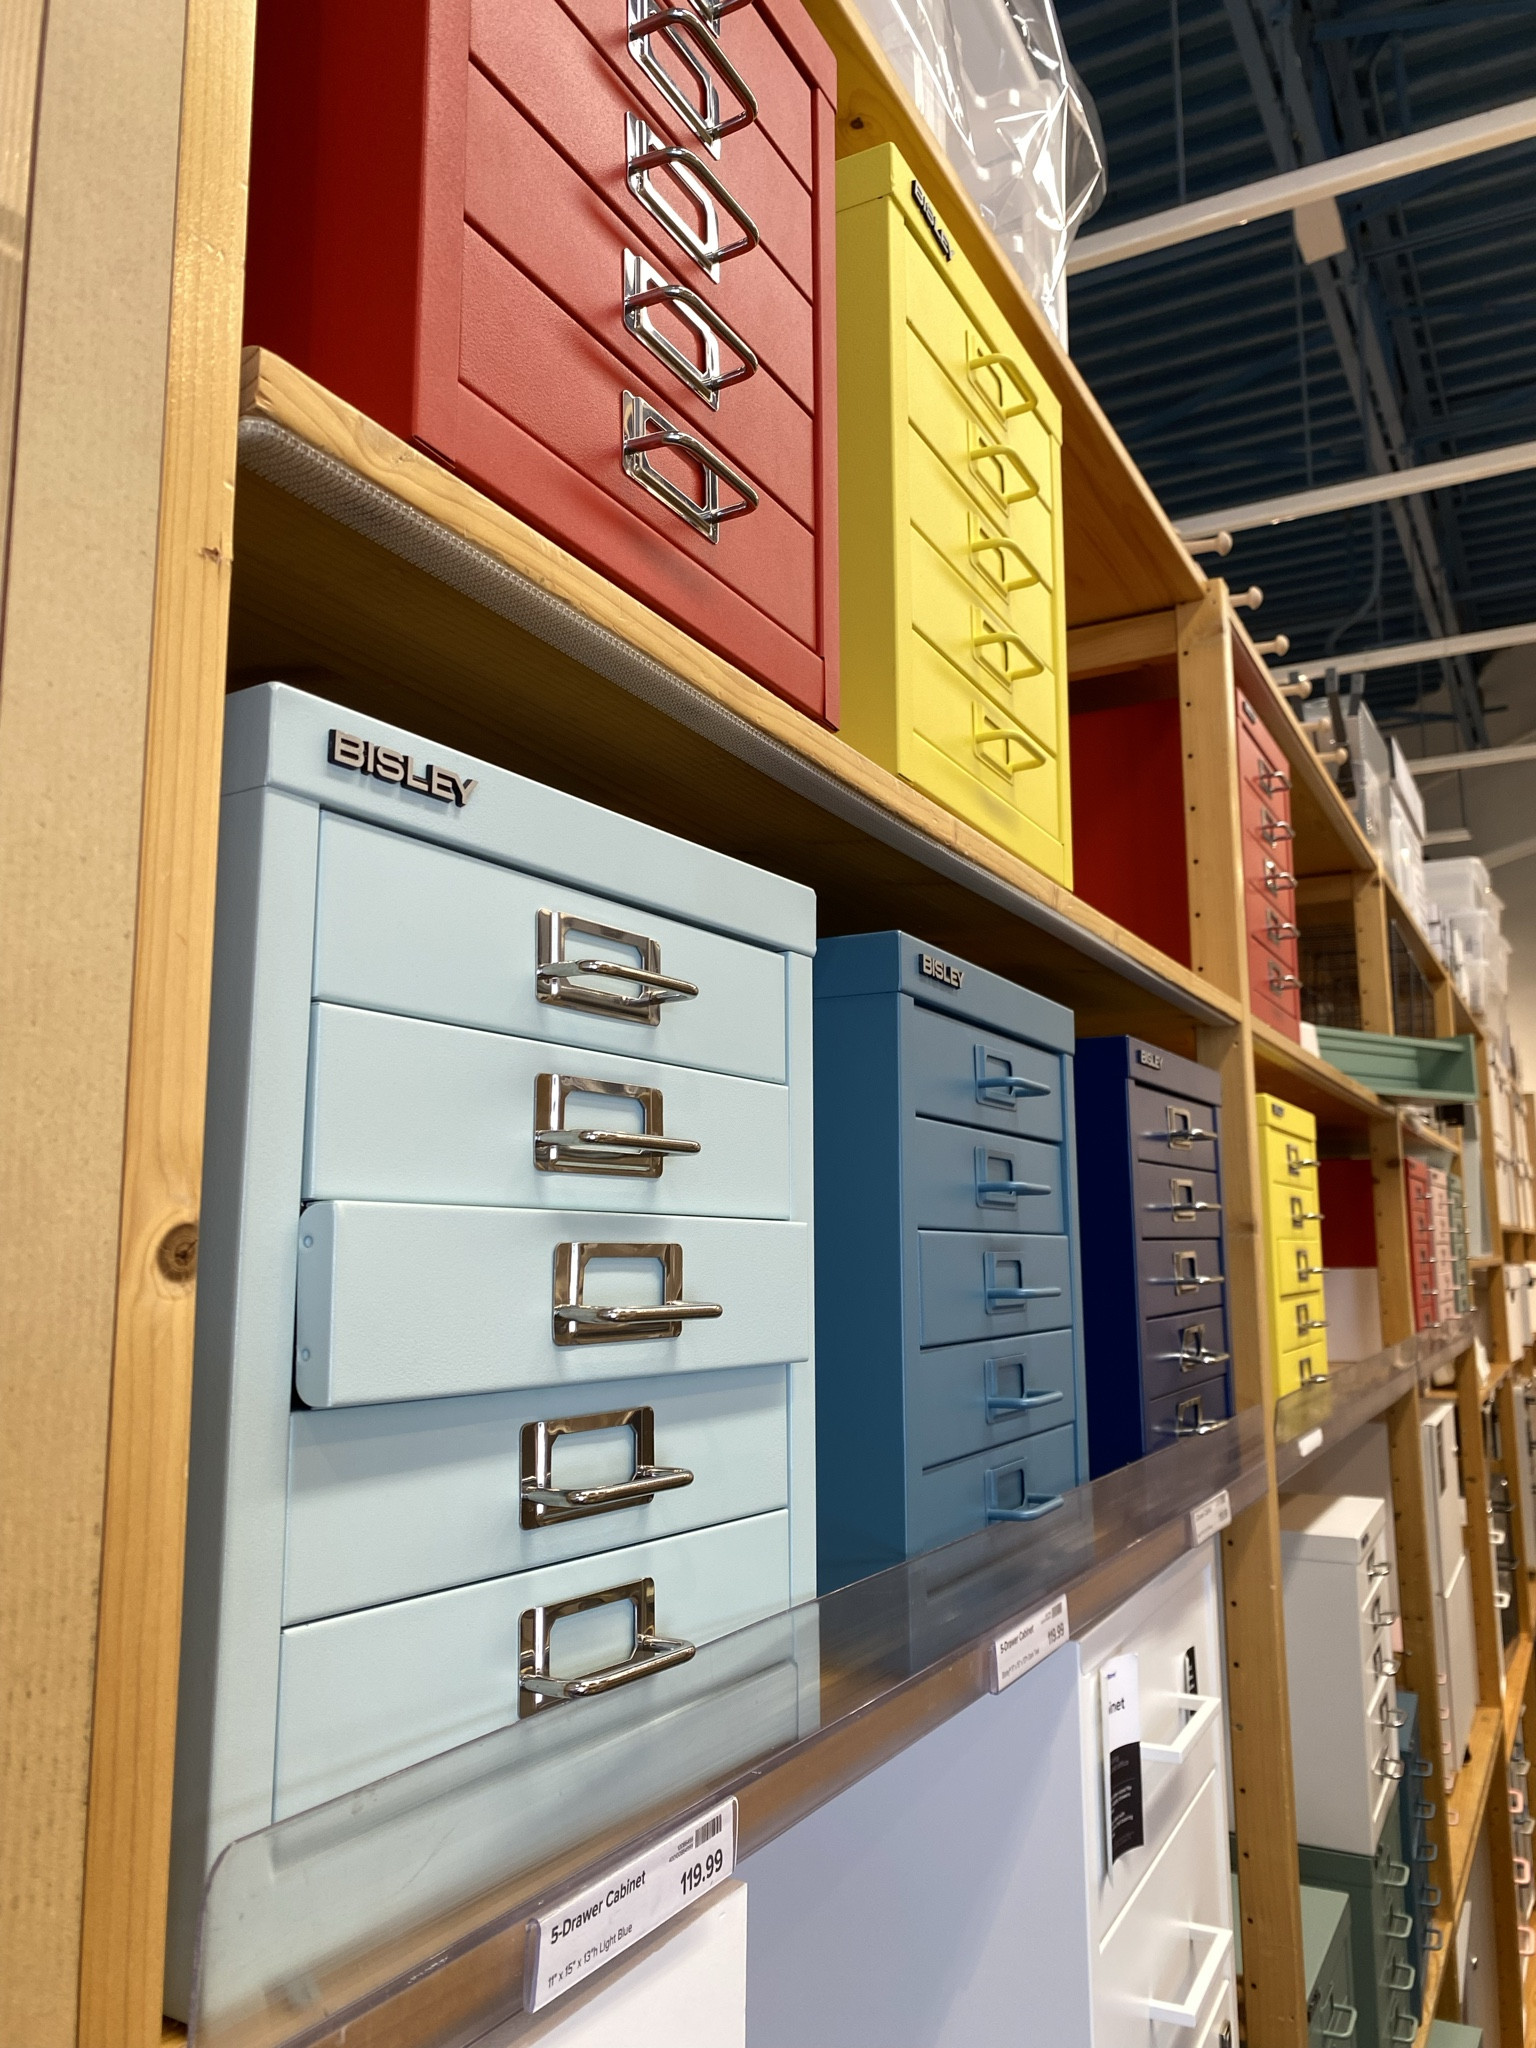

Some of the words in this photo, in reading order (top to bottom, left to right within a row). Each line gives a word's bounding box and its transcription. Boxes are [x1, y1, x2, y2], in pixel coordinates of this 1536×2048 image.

[328, 729, 478, 808] BISLEY
[919, 953, 964, 990] BISLEY
[1136, 1049, 1164, 1071] BISLEY
[681, 1848, 723, 1895] 119.99
[551, 1899, 604, 1945] 5-Drawer
[605, 1869, 646, 1908] Cabinet
[547, 1973, 558, 1989] 11"
[565, 1960, 577, 1975] 15"
[599, 1933, 617, 1954] Light
[617, 1923, 633, 1941] Blue
